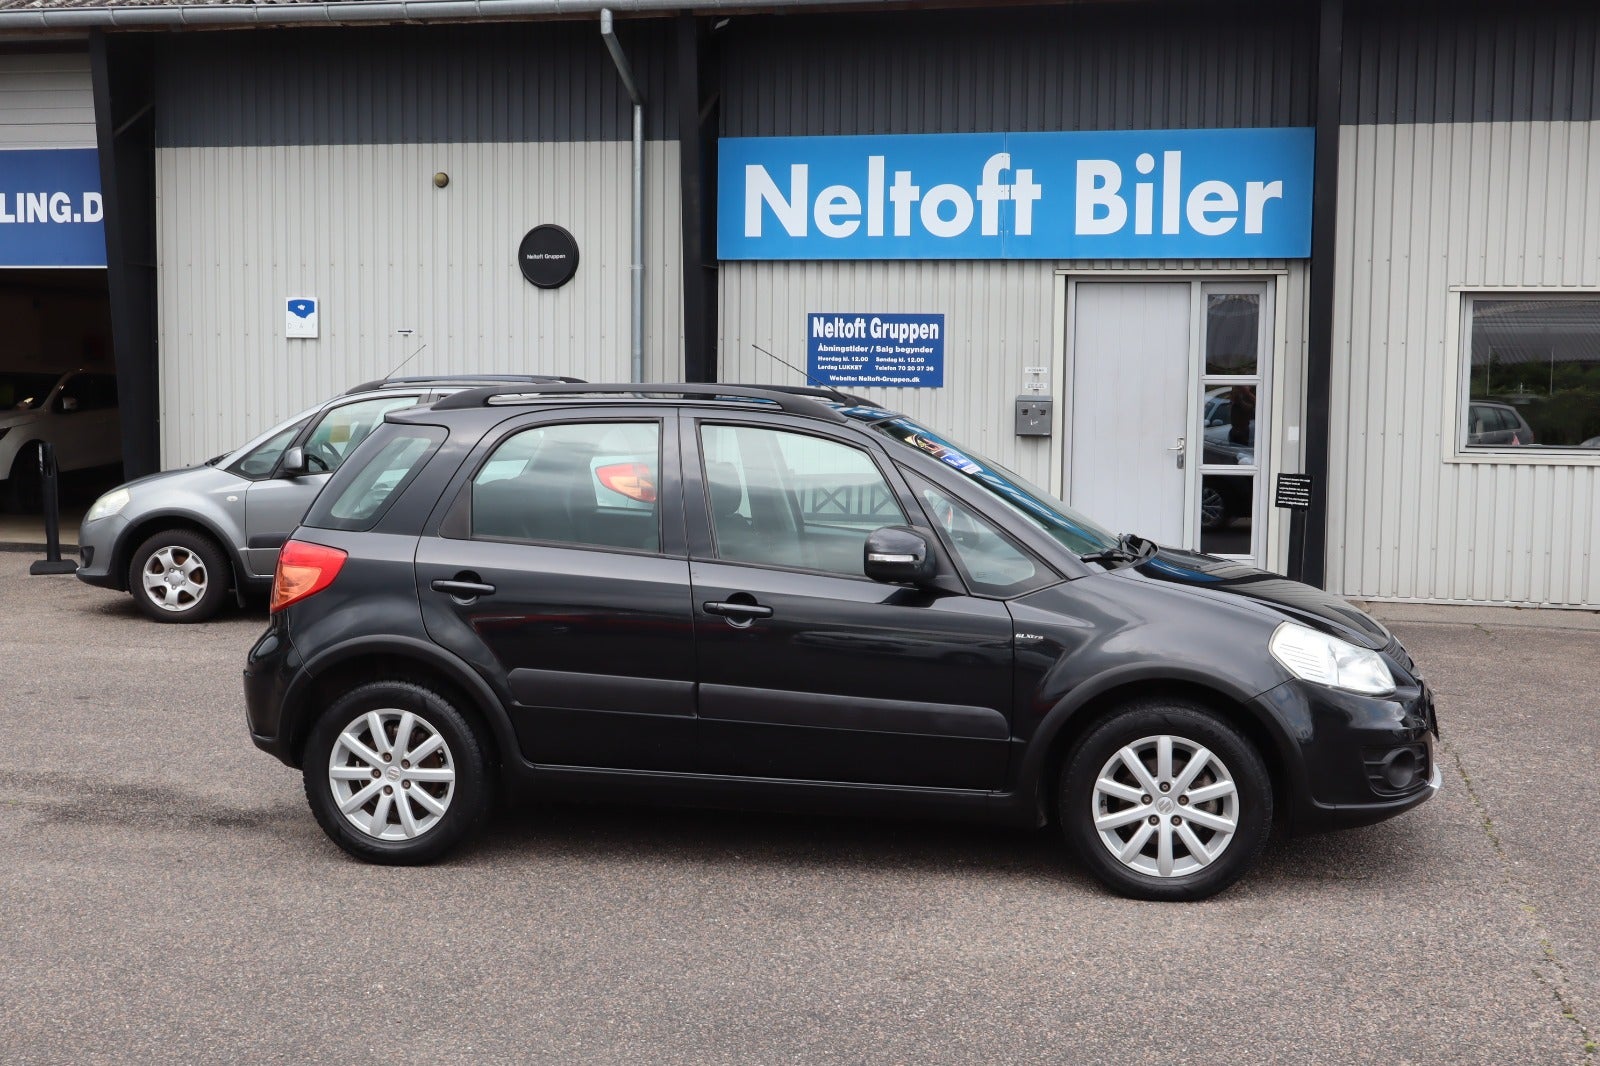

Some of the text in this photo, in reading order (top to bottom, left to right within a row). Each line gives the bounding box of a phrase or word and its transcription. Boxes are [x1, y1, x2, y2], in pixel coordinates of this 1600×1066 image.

[0, 191, 104, 224] LING.D
[744, 150, 1283, 238] Neltoft Biler
[813, 317, 939, 343] Neltoft Gruppen
[818, 343, 934, 354] Åbningstider / Salg begynder
